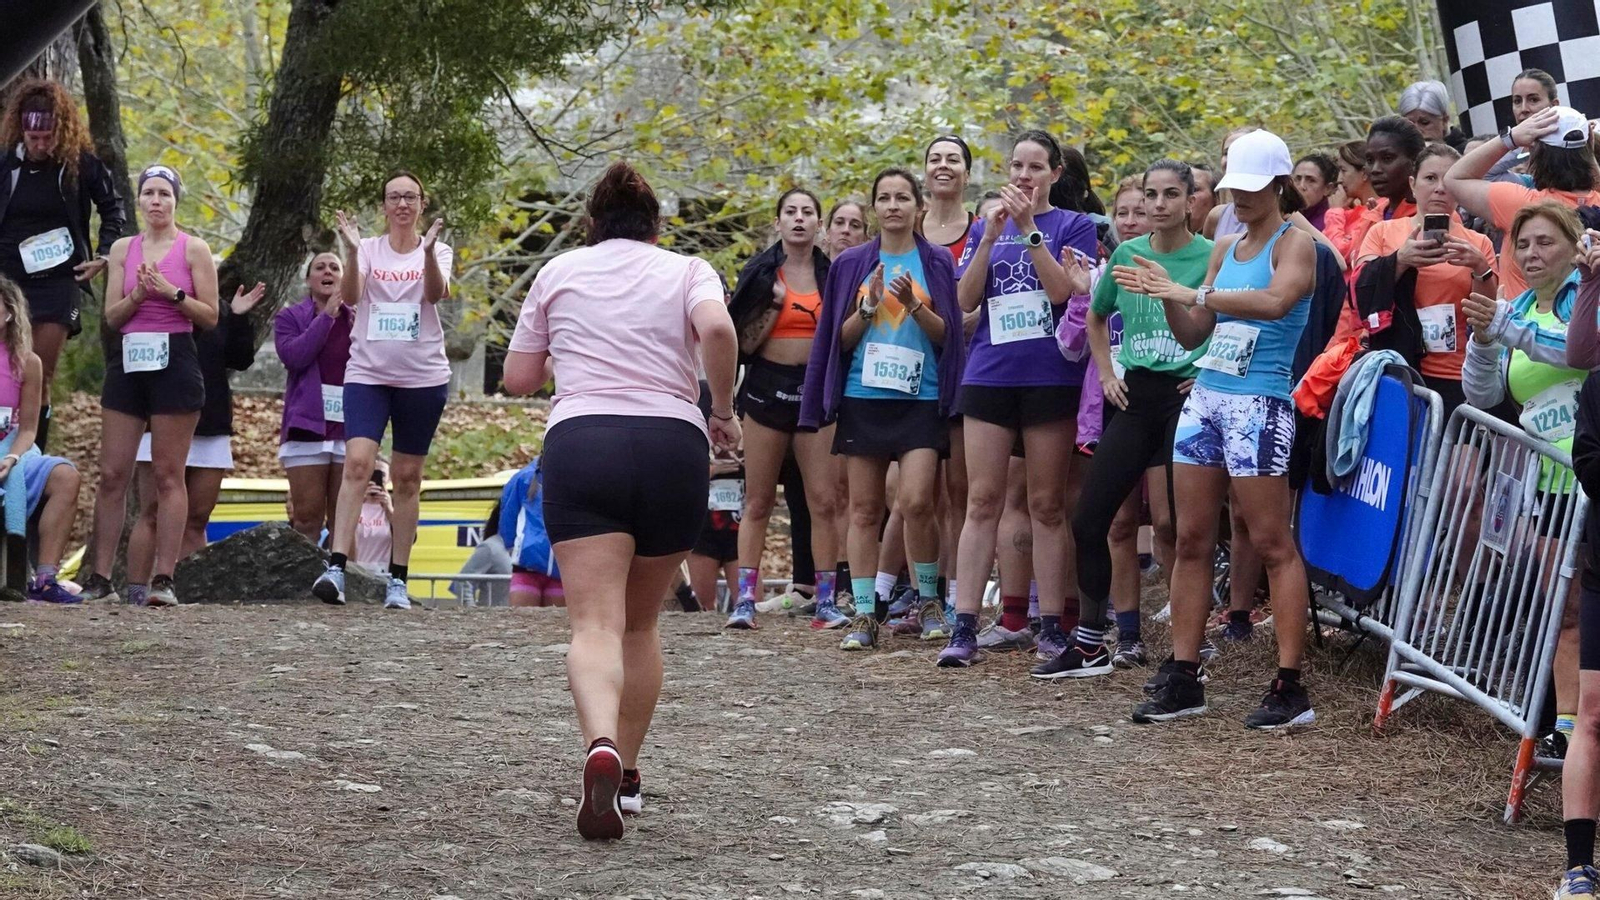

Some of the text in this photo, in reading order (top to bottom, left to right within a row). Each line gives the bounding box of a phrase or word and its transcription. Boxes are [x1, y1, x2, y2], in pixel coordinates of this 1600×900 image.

[30, 244, 62, 262] 1093
[378, 318, 406, 332] 1163
[999, 311, 1036, 331] 1503
[128, 347, 155, 362] 1243
[1207, 341, 1238, 361] 1323
[873, 361, 908, 380] 1533
[1531, 404, 1572, 433] 1224
[714, 491, 738, 503] 1692
